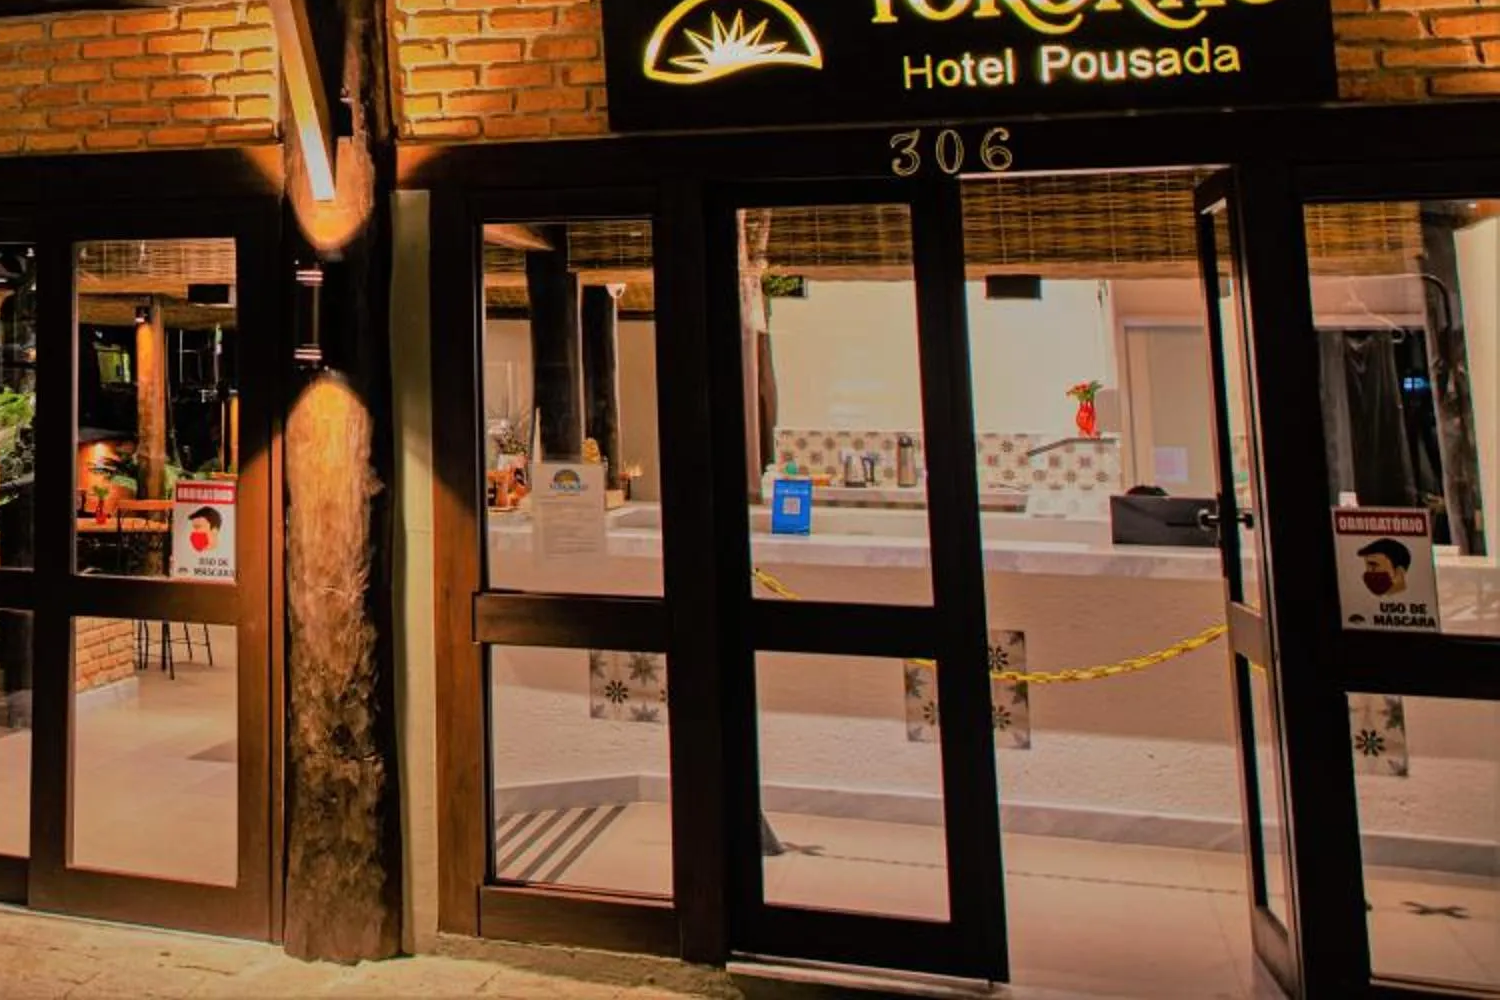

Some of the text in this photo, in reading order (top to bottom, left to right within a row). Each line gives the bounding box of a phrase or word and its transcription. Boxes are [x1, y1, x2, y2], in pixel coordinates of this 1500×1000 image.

[903, 38, 1242, 91] Hotel Pousada
[890, 127, 1014, 178] 306
[1379, 601, 1428, 615] USO DE
